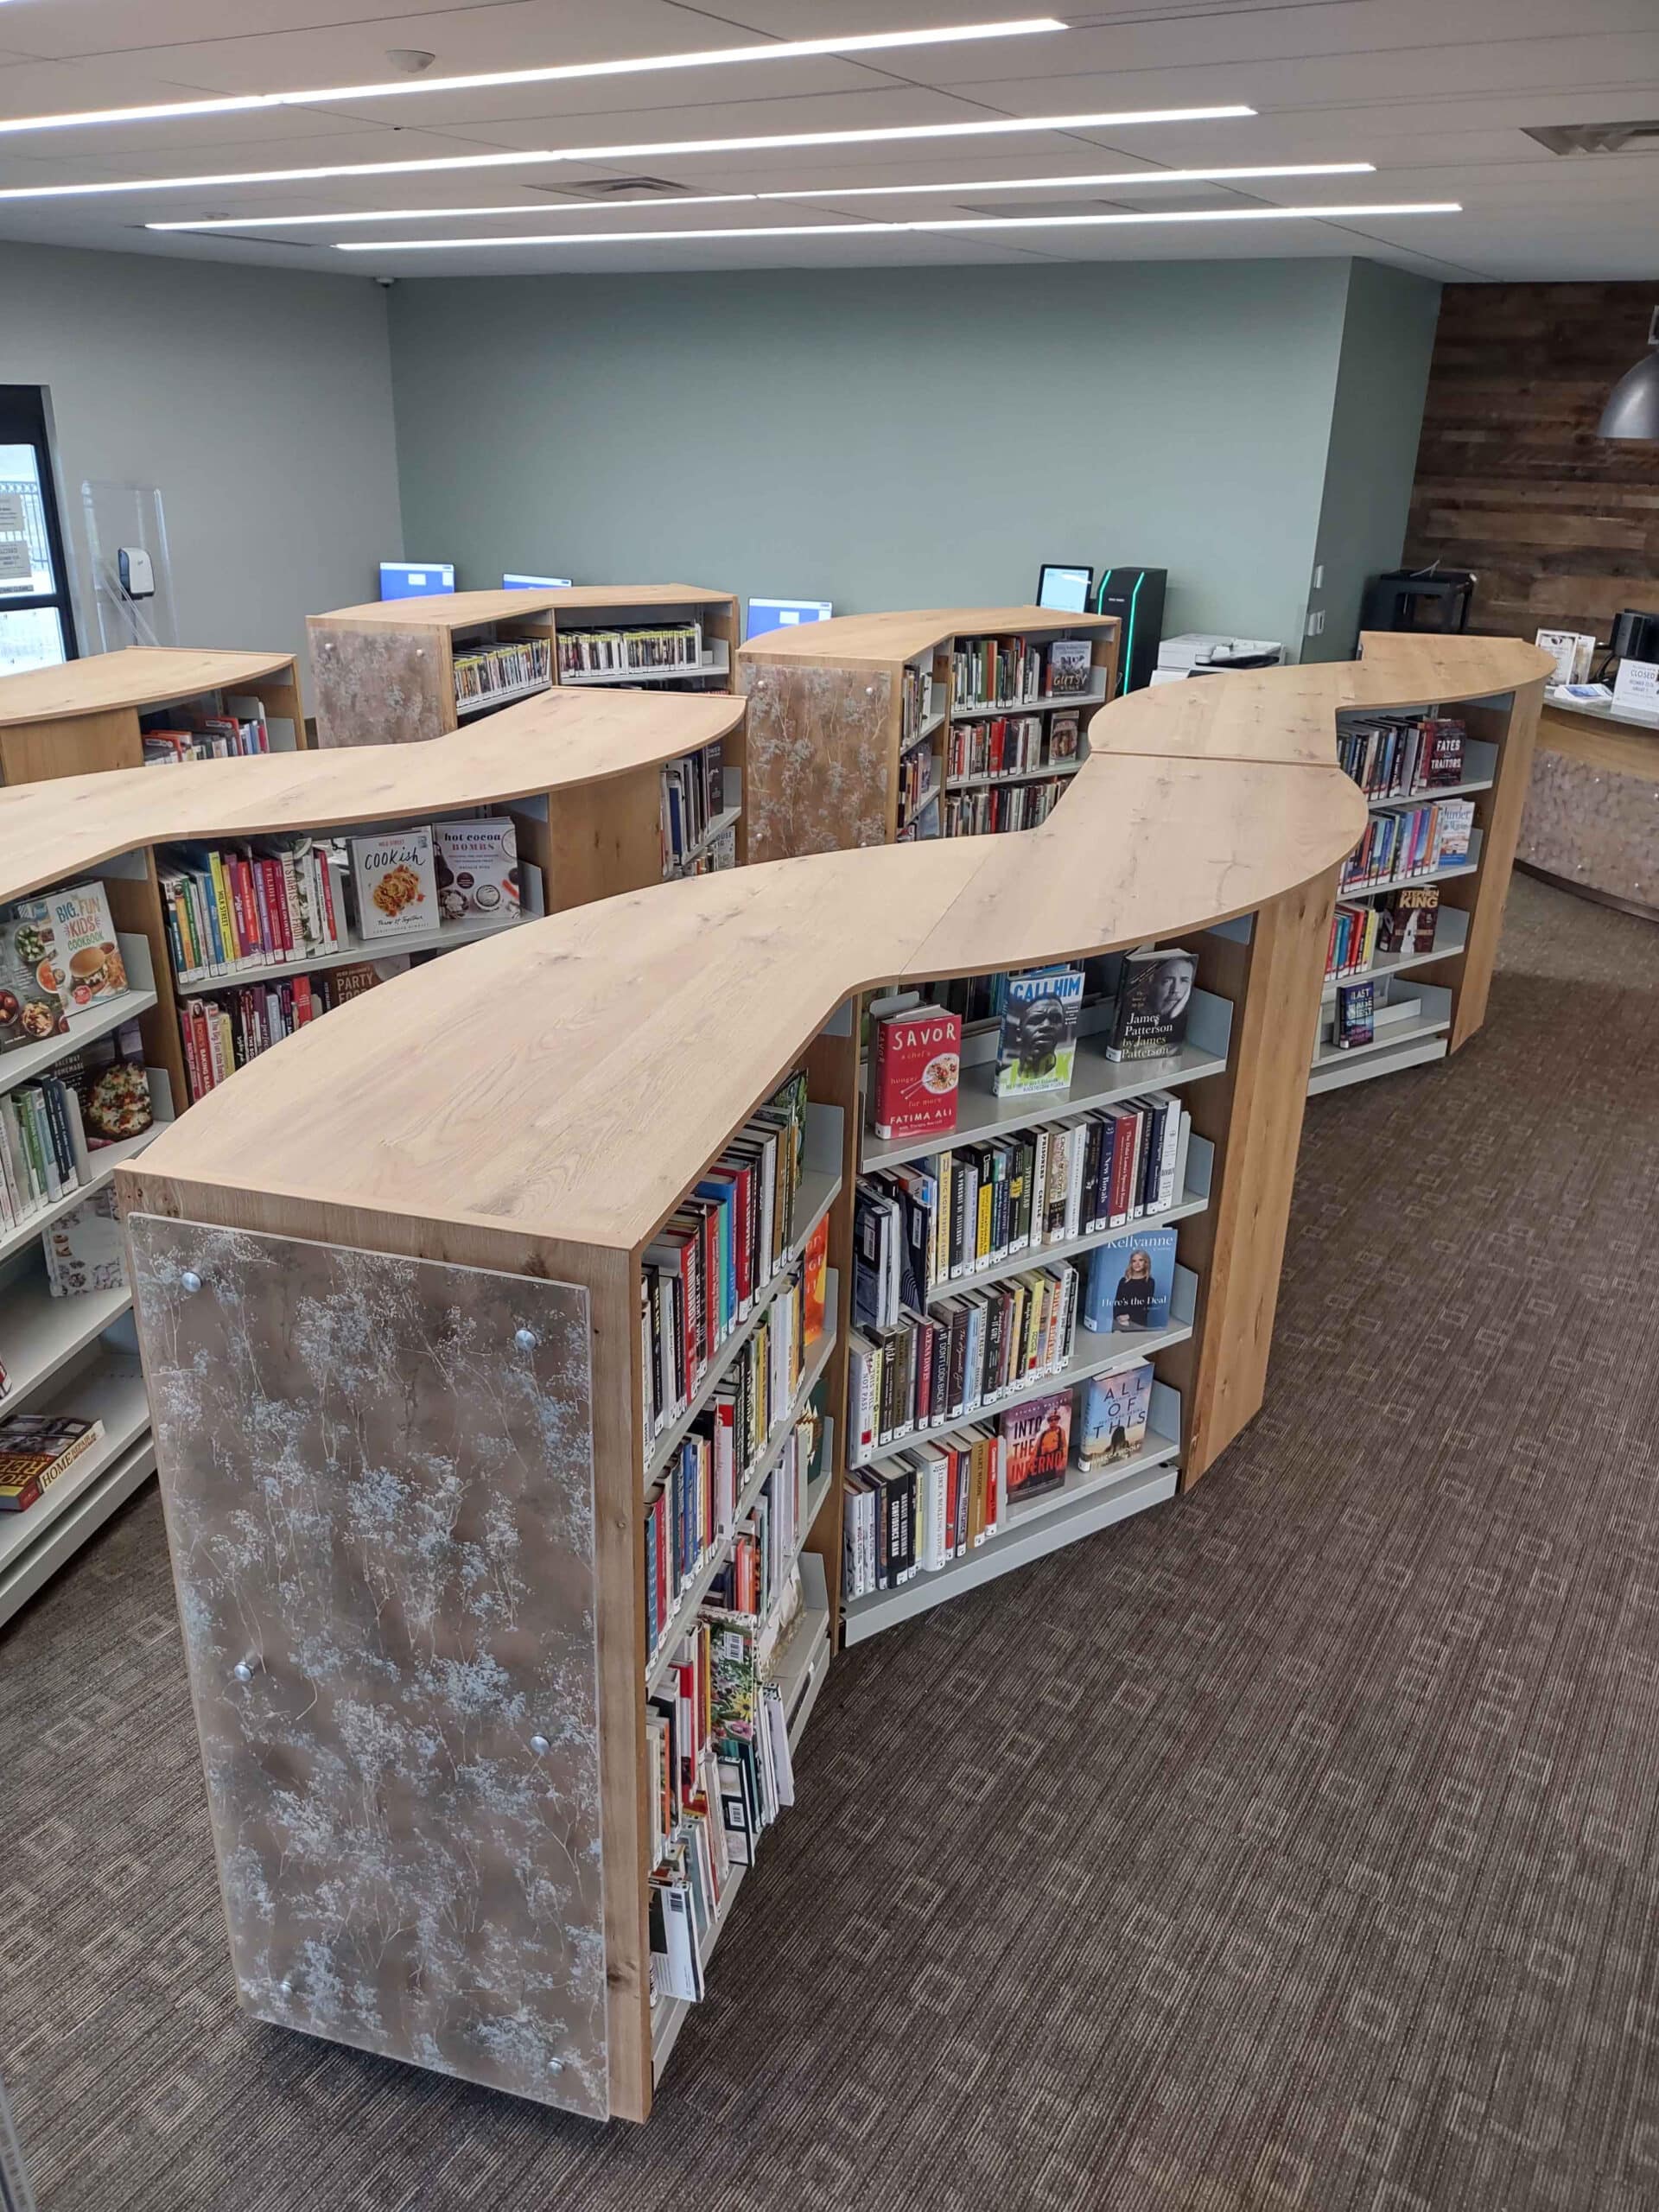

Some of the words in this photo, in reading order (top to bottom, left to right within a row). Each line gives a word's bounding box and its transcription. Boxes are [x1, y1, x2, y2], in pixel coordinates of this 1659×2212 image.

[1054, 675, 1087, 686] GUTSY
[1437, 740, 1461, 752] FATES
[1431, 759, 1462, 769] TRAITORS
[444, 833, 465, 842] hot
[467, 833, 501, 842] cocoa
[452, 842, 495, 851] BOMBS
[79, 897, 101, 916] FUN
[1400, 896, 1439, 908] KING
[219, 904, 229, 927] STREET
[69, 915, 96, 937] KIDS
[67, 931, 105, 950] COOKBOOK
[337, 971, 374, 990] PARTY
[1053, 976, 1081, 997] HIM
[338, 988, 366, 1004] FOO
[1127, 1013, 1160, 1025] James
[893, 1022, 957, 1051] SAVOR
[1124, 1024, 1173, 1036] Patterson
[1122, 1038, 1134, 1047] by
[1134, 1036, 1166, 1047] James
[200, 1049, 209, 1074] BAKING
[1122, 1047, 1170, 1058] Patterson
[890, 1111, 931, 1125] FATIMA
[935, 1109, 952, 1118] ALI
[1039, 1135, 1048, 1179] PRISONERS
[1103, 1156, 1112, 1174] New
[1100, 1176, 1110, 1204] Royals
[1107, 1236, 1173, 1250] Kellyanne
[687, 1244, 696, 1333] FORMIDABLE
[1102, 1297, 1128, 1307] Here's
[1130, 1297, 1145, 1306] the
[1147, 1295, 1166, 1305] Deal
[884, 1341, 896, 1363] Wild
[925, 1328, 933, 1358] GEENA
[938, 1341, 947, 1363] DON'T
[937, 1364, 945, 1382] LOOK
[936, 1383, 944, 1402] BACK
[1103, 1378, 1144, 1402] ALL
[1108, 1397, 1137, 1416] OF
[1014, 1415, 1043, 1440] INTO
[1093, 1411, 1146, 1439] THIS
[1013, 1438, 1035, 1459] THE
[41, 1453, 74, 1487] HOME
[1011, 1451, 1066, 1481] INFERNO
